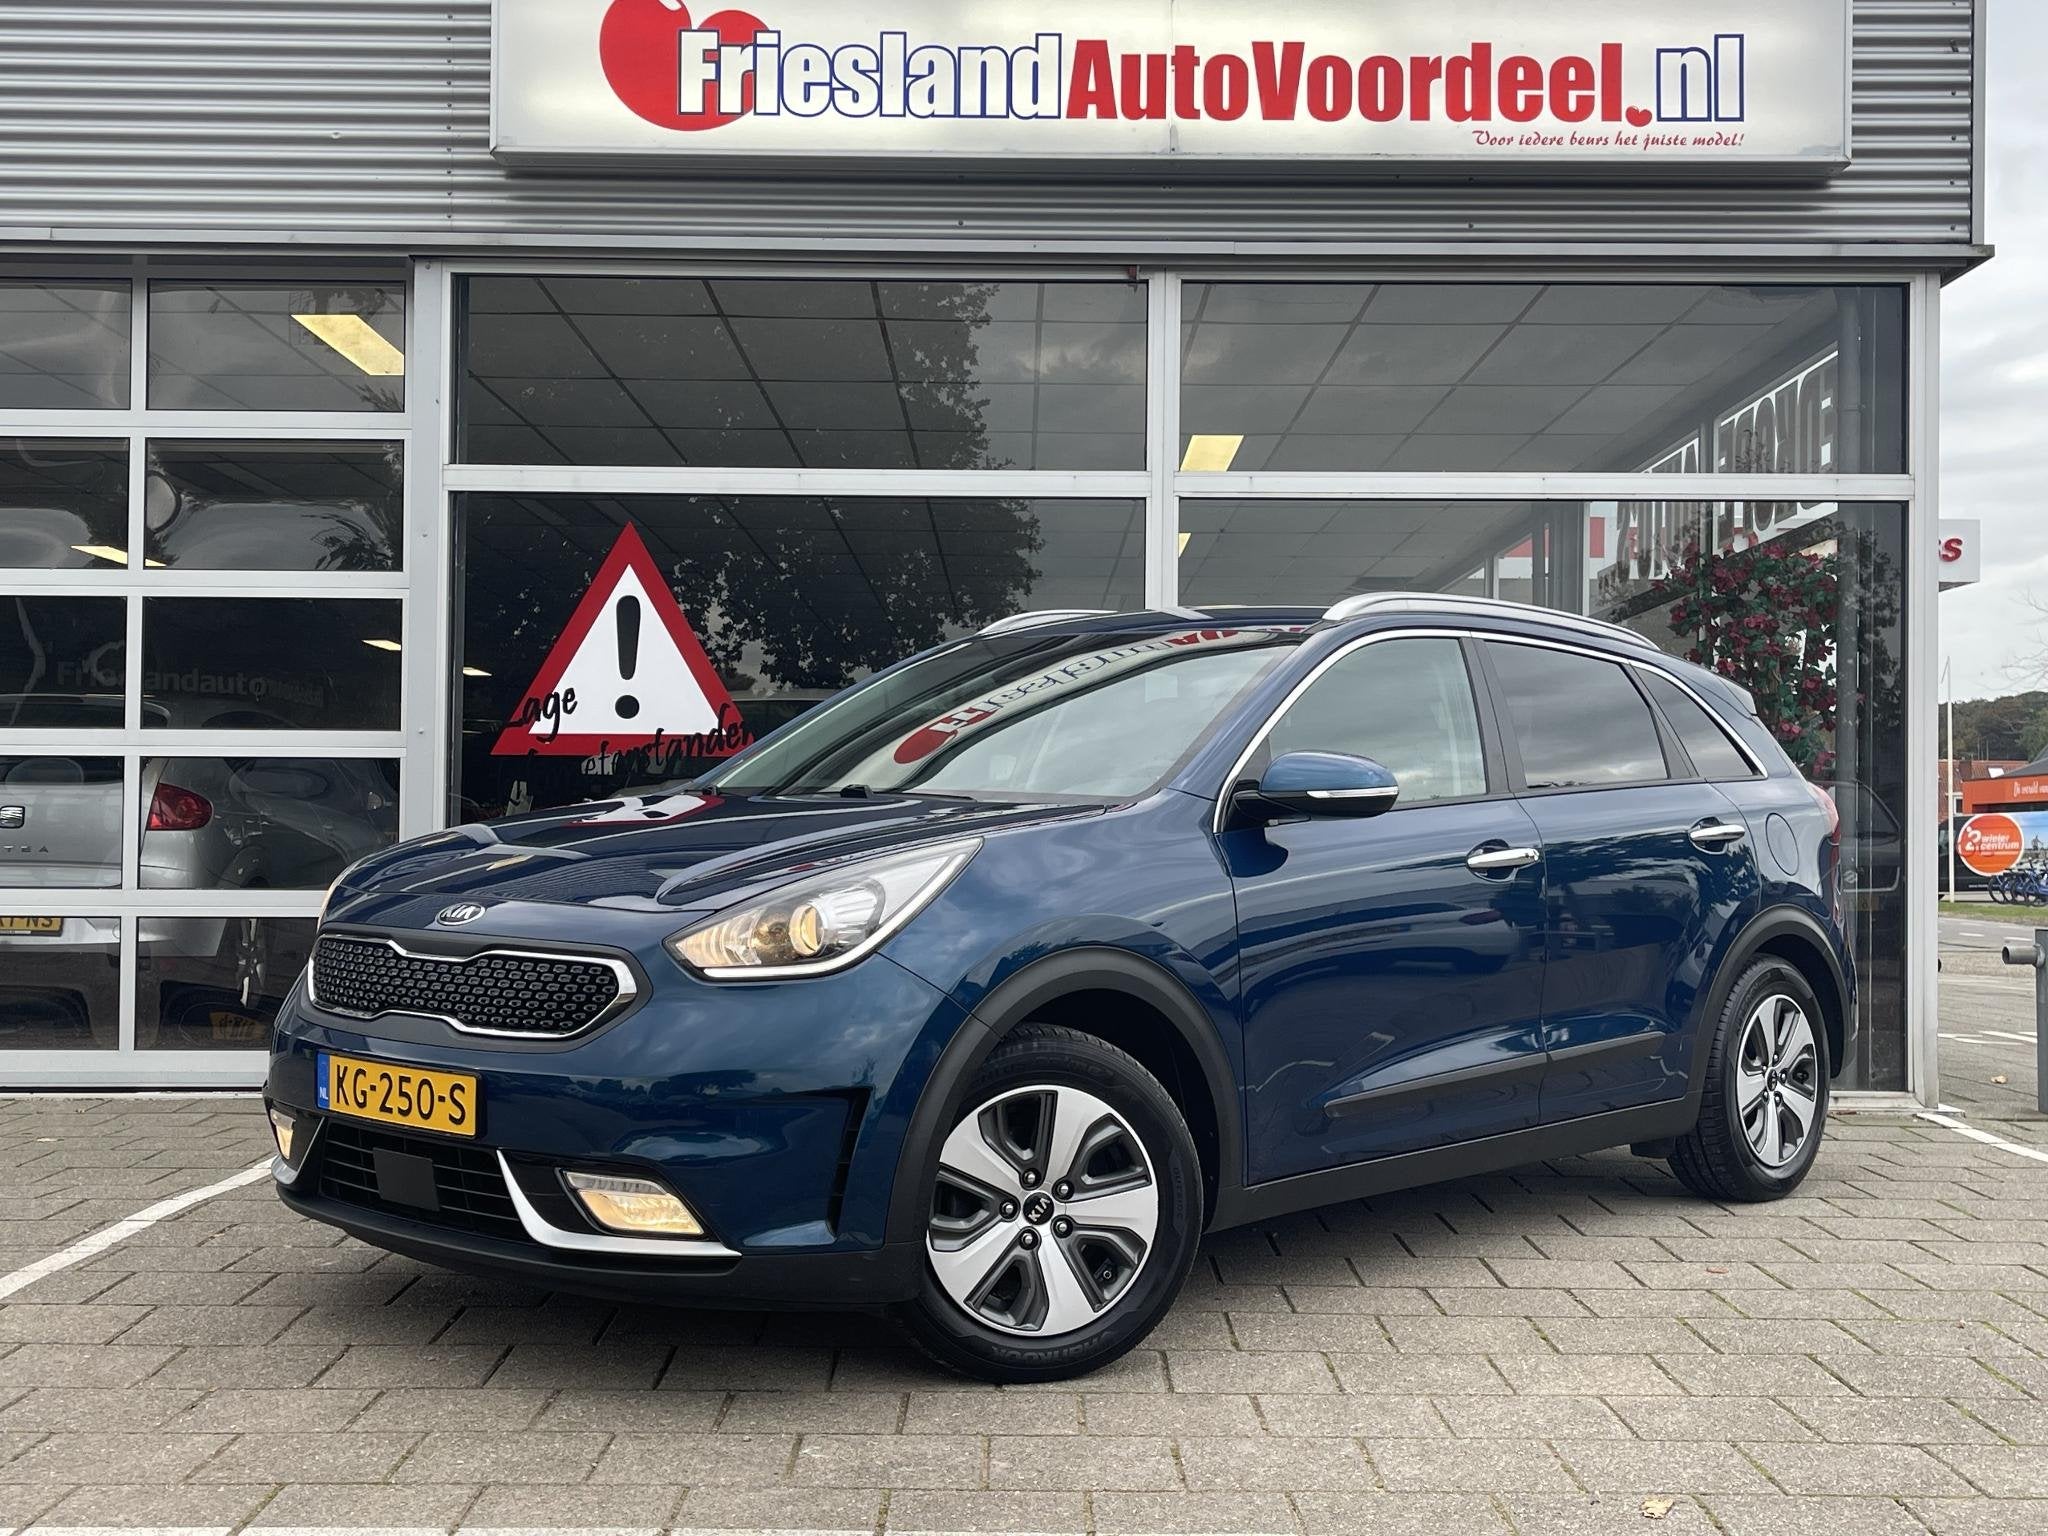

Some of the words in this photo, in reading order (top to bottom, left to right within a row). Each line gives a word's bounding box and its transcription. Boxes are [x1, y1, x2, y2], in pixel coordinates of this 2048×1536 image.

[1472, 130, 1514, 146] Voor
[1519, 130, 1564, 146] iedere
[1569, 130, 1610, 146] beurs
[1614, 130, 1638, 146] het
[1643, 130, 1687, 151] juiste
[1692, 130, 1745, 146] model!
[319, 1086, 329, 1101] NL
[336, 1064, 467, 1126] KG-250-S
[1028, 1198, 1050, 1222] KIA
